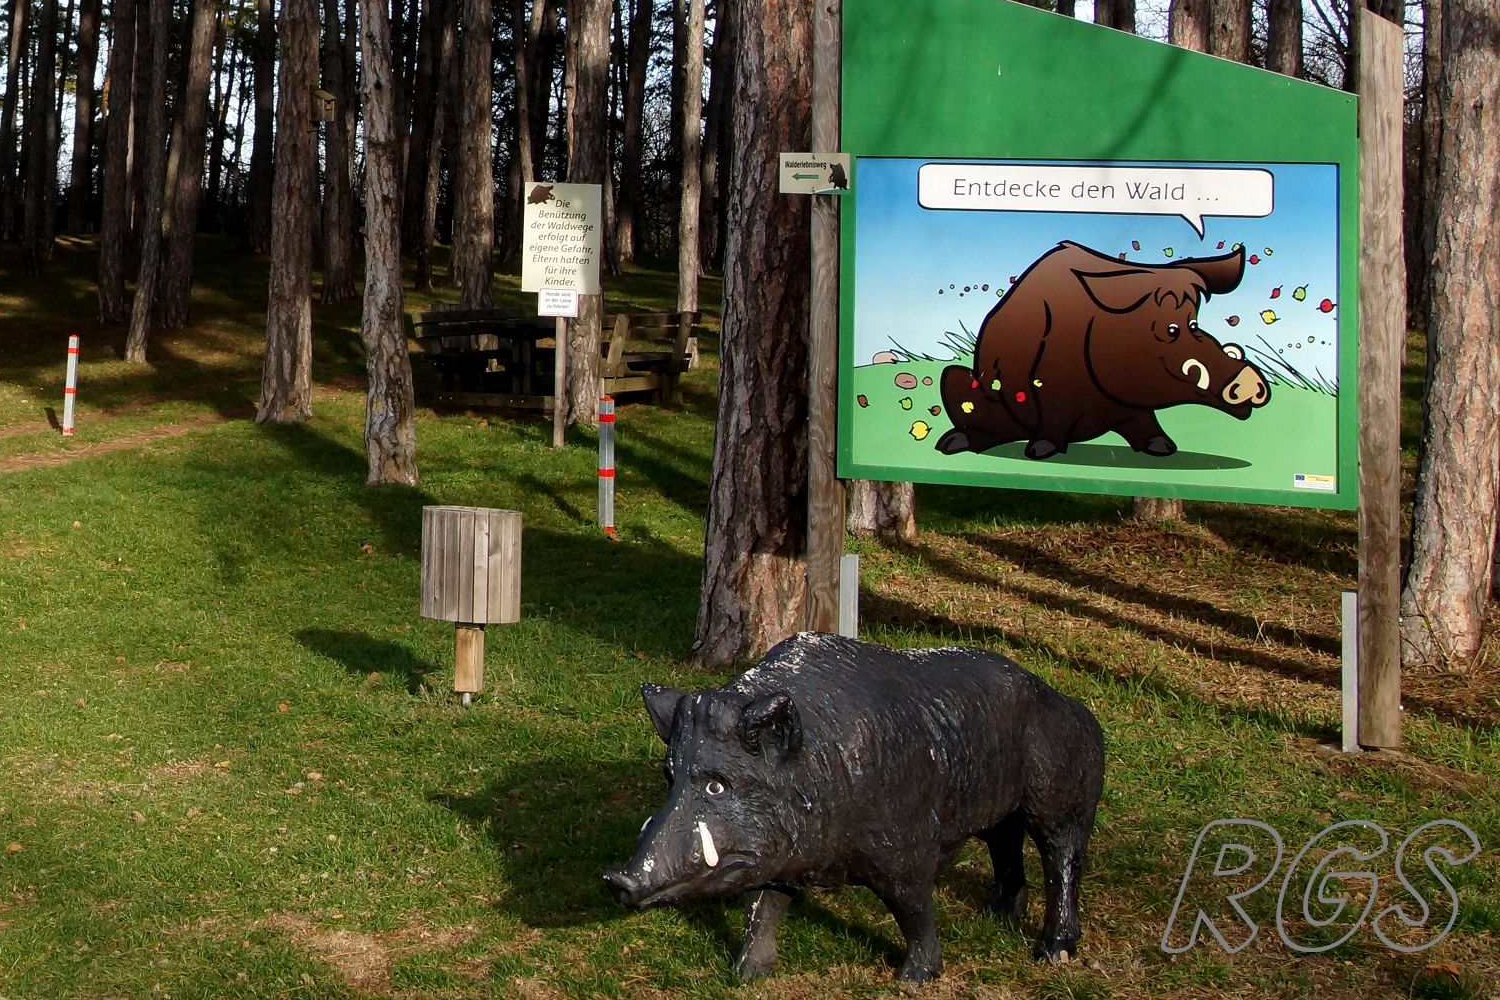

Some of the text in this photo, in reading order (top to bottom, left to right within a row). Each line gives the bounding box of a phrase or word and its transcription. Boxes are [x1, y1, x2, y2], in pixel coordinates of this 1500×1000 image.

[784, 161, 827, 170] Walderlebnisweg
[953, 178, 1061, 199] Entdecke
[1071, 181, 1115, 199] den
[1125, 181, 1186, 201] Wald
[555, 199, 571, 208] Die
[538, 209, 587, 221] Benützung
[530, 220, 594, 233] der Waldwege
[538, 232, 587, 243] erfolgt auf
[529, 243, 594, 255] eigene Gefahr,
[532, 254, 590, 265] Eltern haften
[544, 265, 577, 275] für ihre
[544, 277, 576, 287] Kinder.
